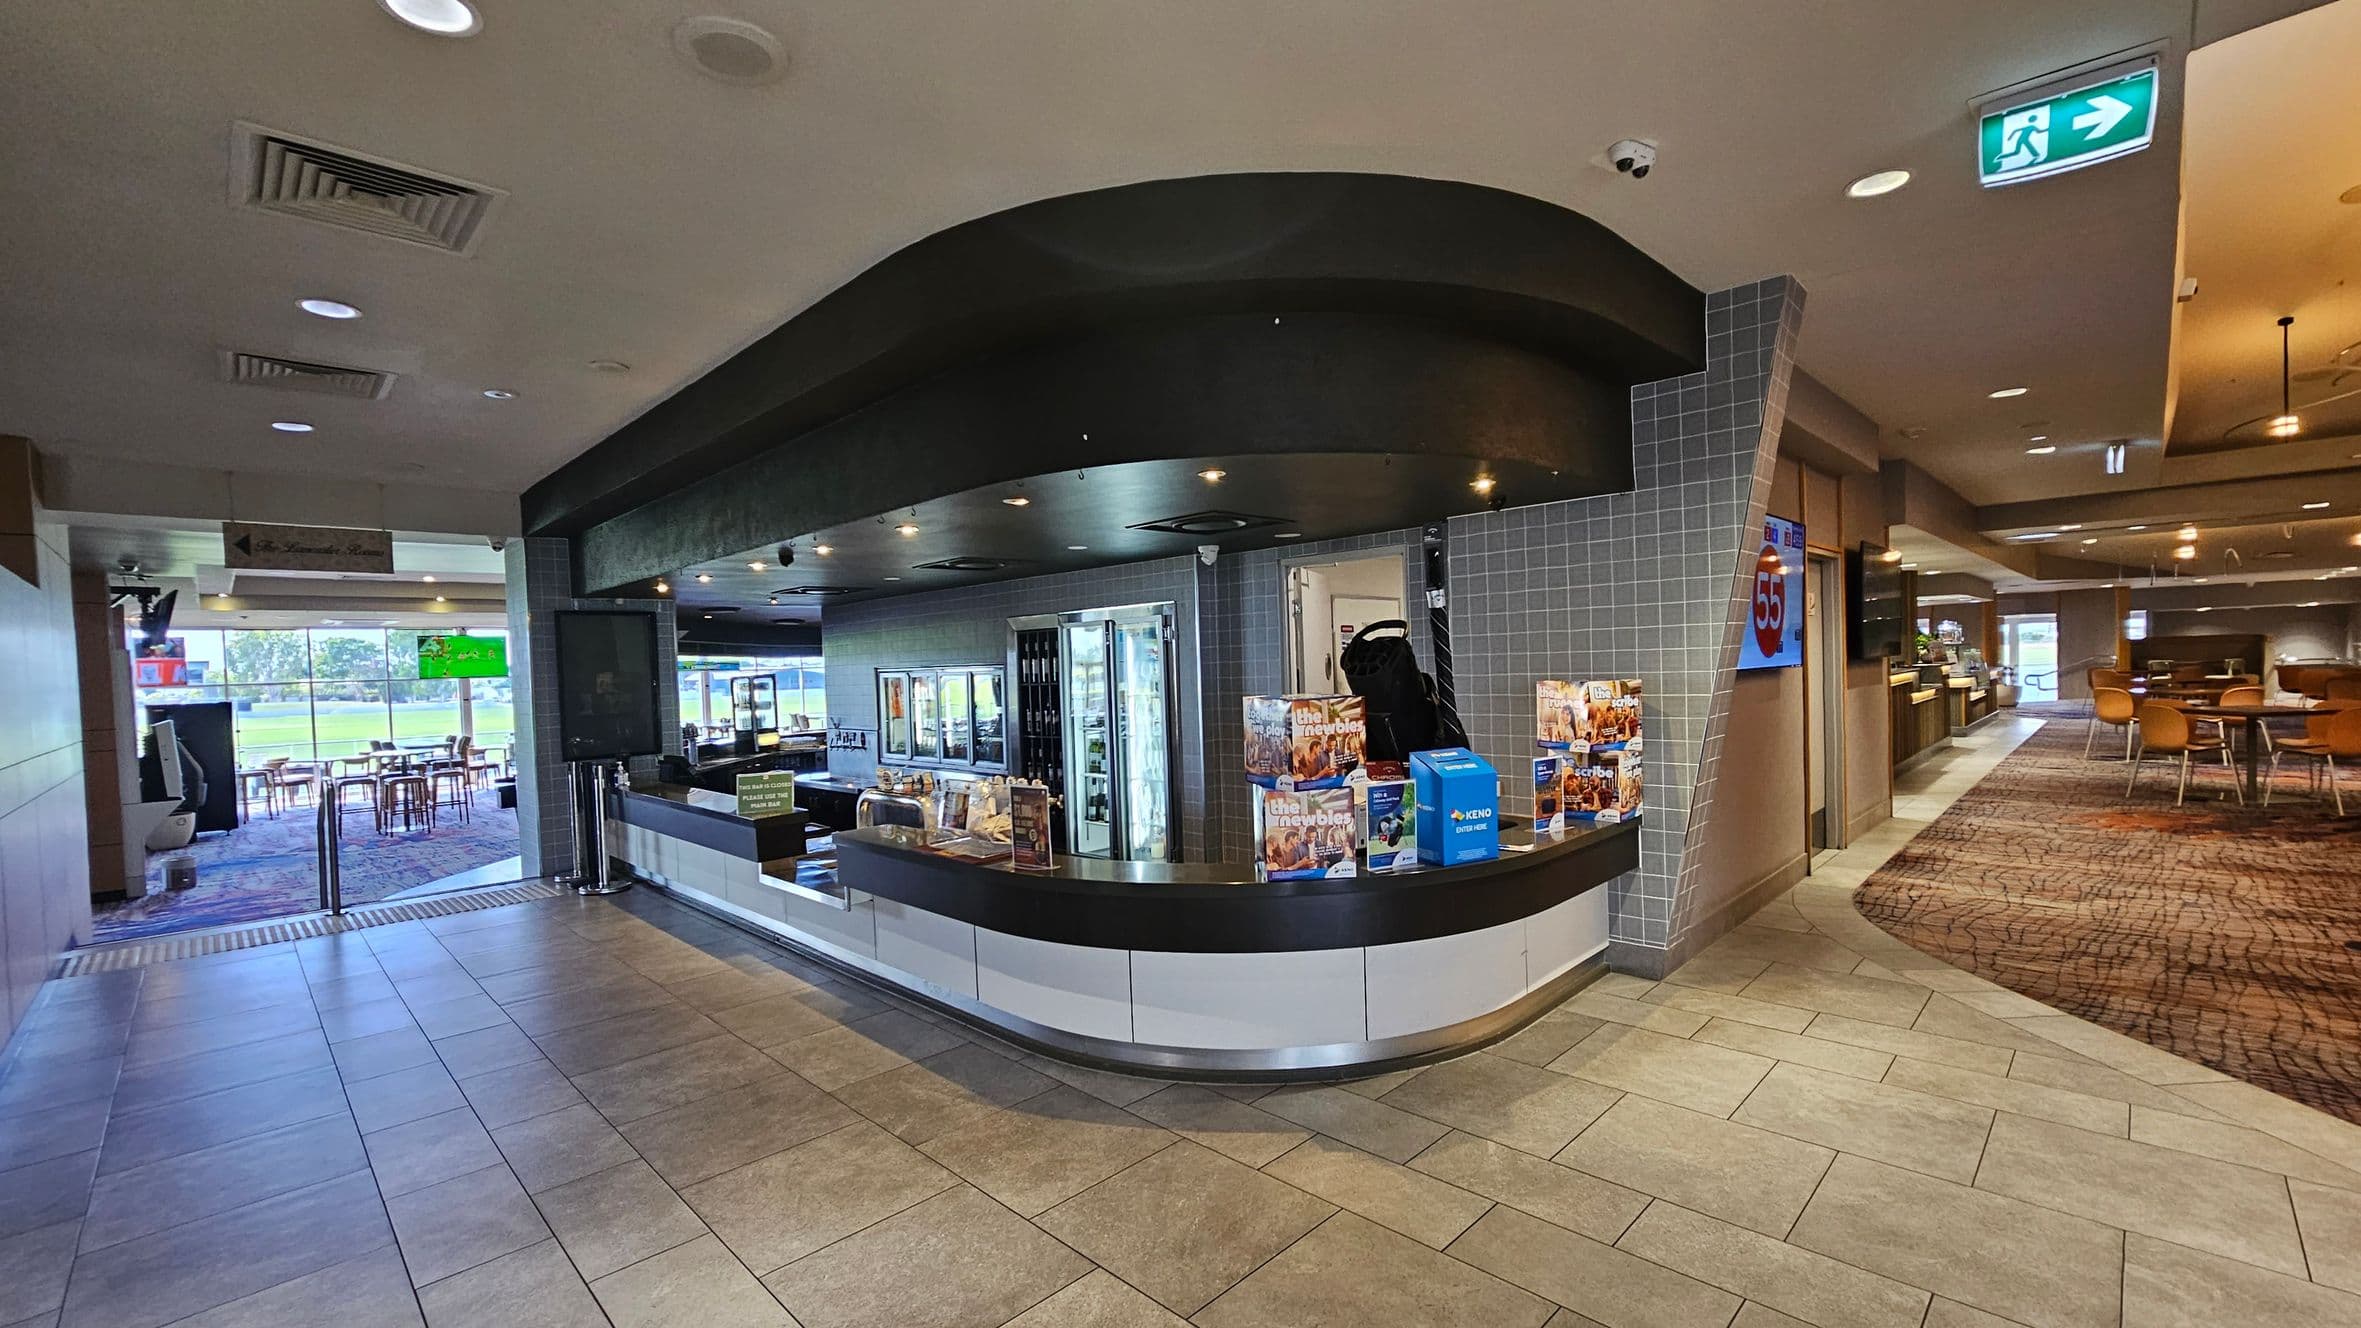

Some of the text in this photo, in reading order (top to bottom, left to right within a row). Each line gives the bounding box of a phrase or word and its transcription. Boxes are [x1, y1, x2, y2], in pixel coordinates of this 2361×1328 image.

[1757, 572, 1782, 630] 55
[1594, 687, 1611, 699] the
[1612, 694, 1639, 708] scribe
[1296, 706, 1323, 725] the
[1266, 722, 1286, 740] play
[1303, 717, 1364, 737] newbies
[1575, 765, 1614, 778] scribe
[1270, 797, 1300, 815] the
[1465, 808, 1492, 820] KENO
[1279, 809, 1352, 827] newbies
[1456, 823, 1488, 834] ENTER HERE
